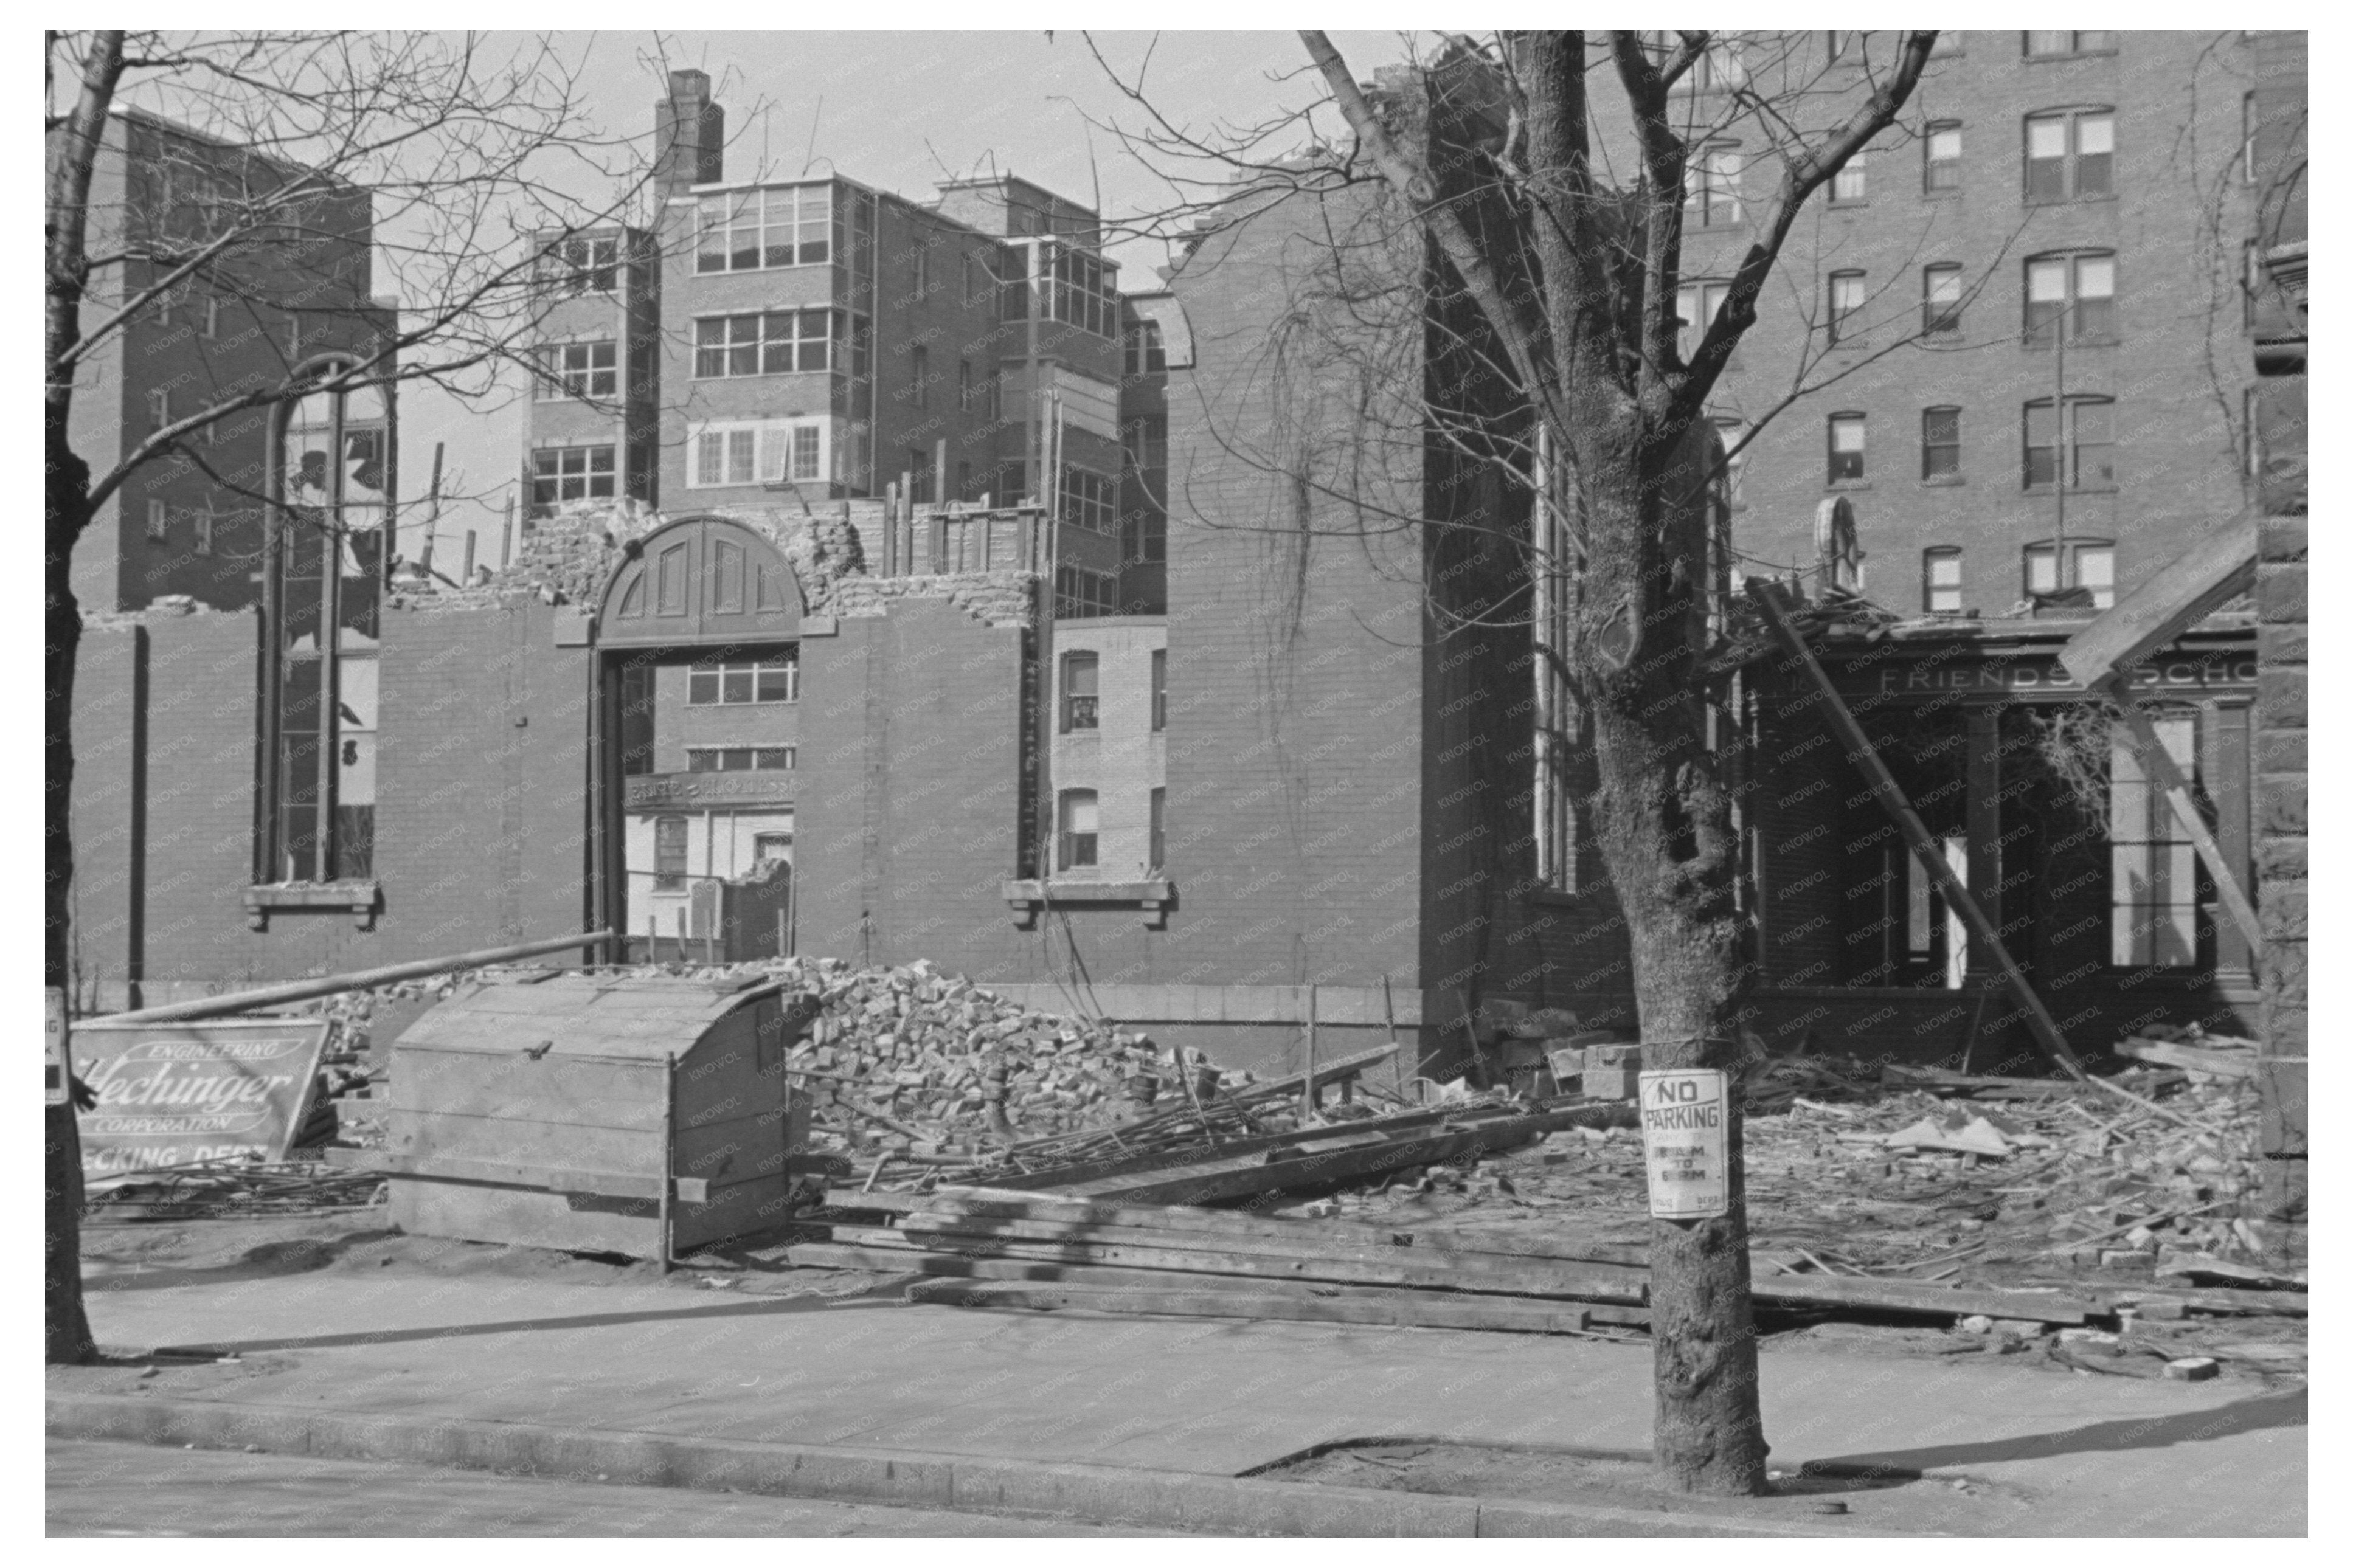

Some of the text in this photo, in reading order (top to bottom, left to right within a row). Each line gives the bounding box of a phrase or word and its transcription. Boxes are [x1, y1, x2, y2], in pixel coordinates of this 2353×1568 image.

[148, 1041, 279, 1058] ENGINEERING
[78, 1055, 294, 1113] Hechinger
[1658, 1080, 1698, 1103] NO
[95, 1115, 235, 1133] CORPORATION
[1646, 1106, 1719, 1130] PARKING
[1674, 1159, 1693, 1169] TO
